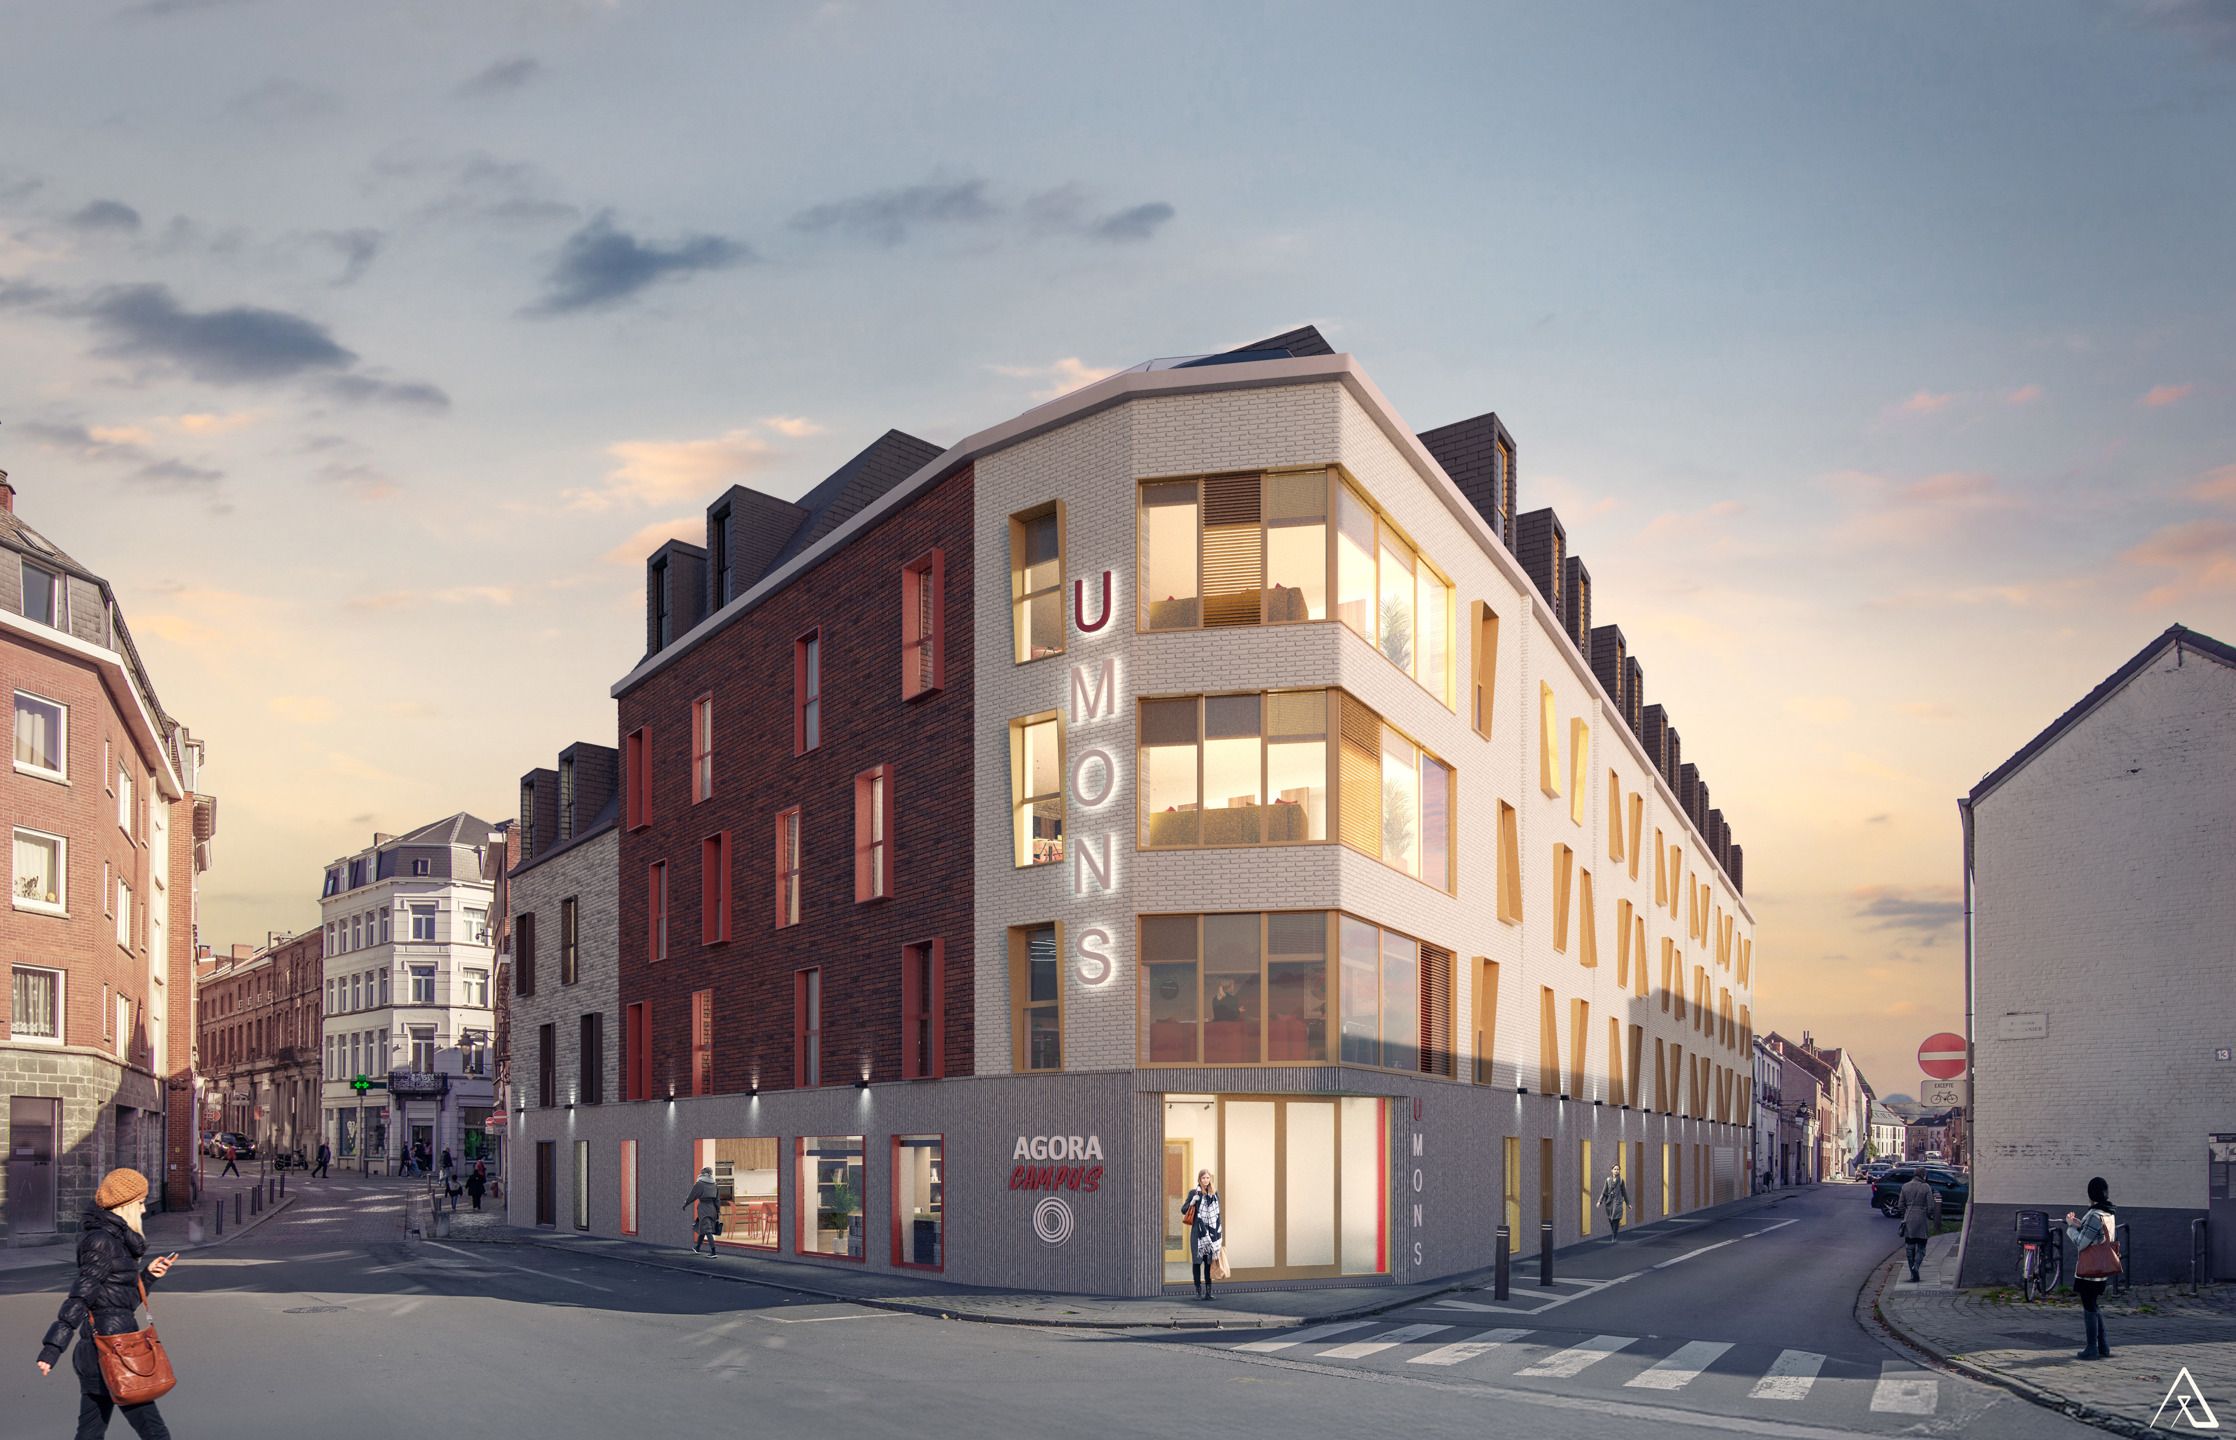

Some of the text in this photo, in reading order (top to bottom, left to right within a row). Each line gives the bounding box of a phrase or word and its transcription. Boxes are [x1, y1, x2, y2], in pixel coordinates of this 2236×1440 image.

[1071, 570, 1116, 986] UMONS
[2216, 1050, 2229, 1060] 13
[1012, 1135, 1104, 1161] AGORA
[1009, 1163, 1104, 1193] CAMPUS
